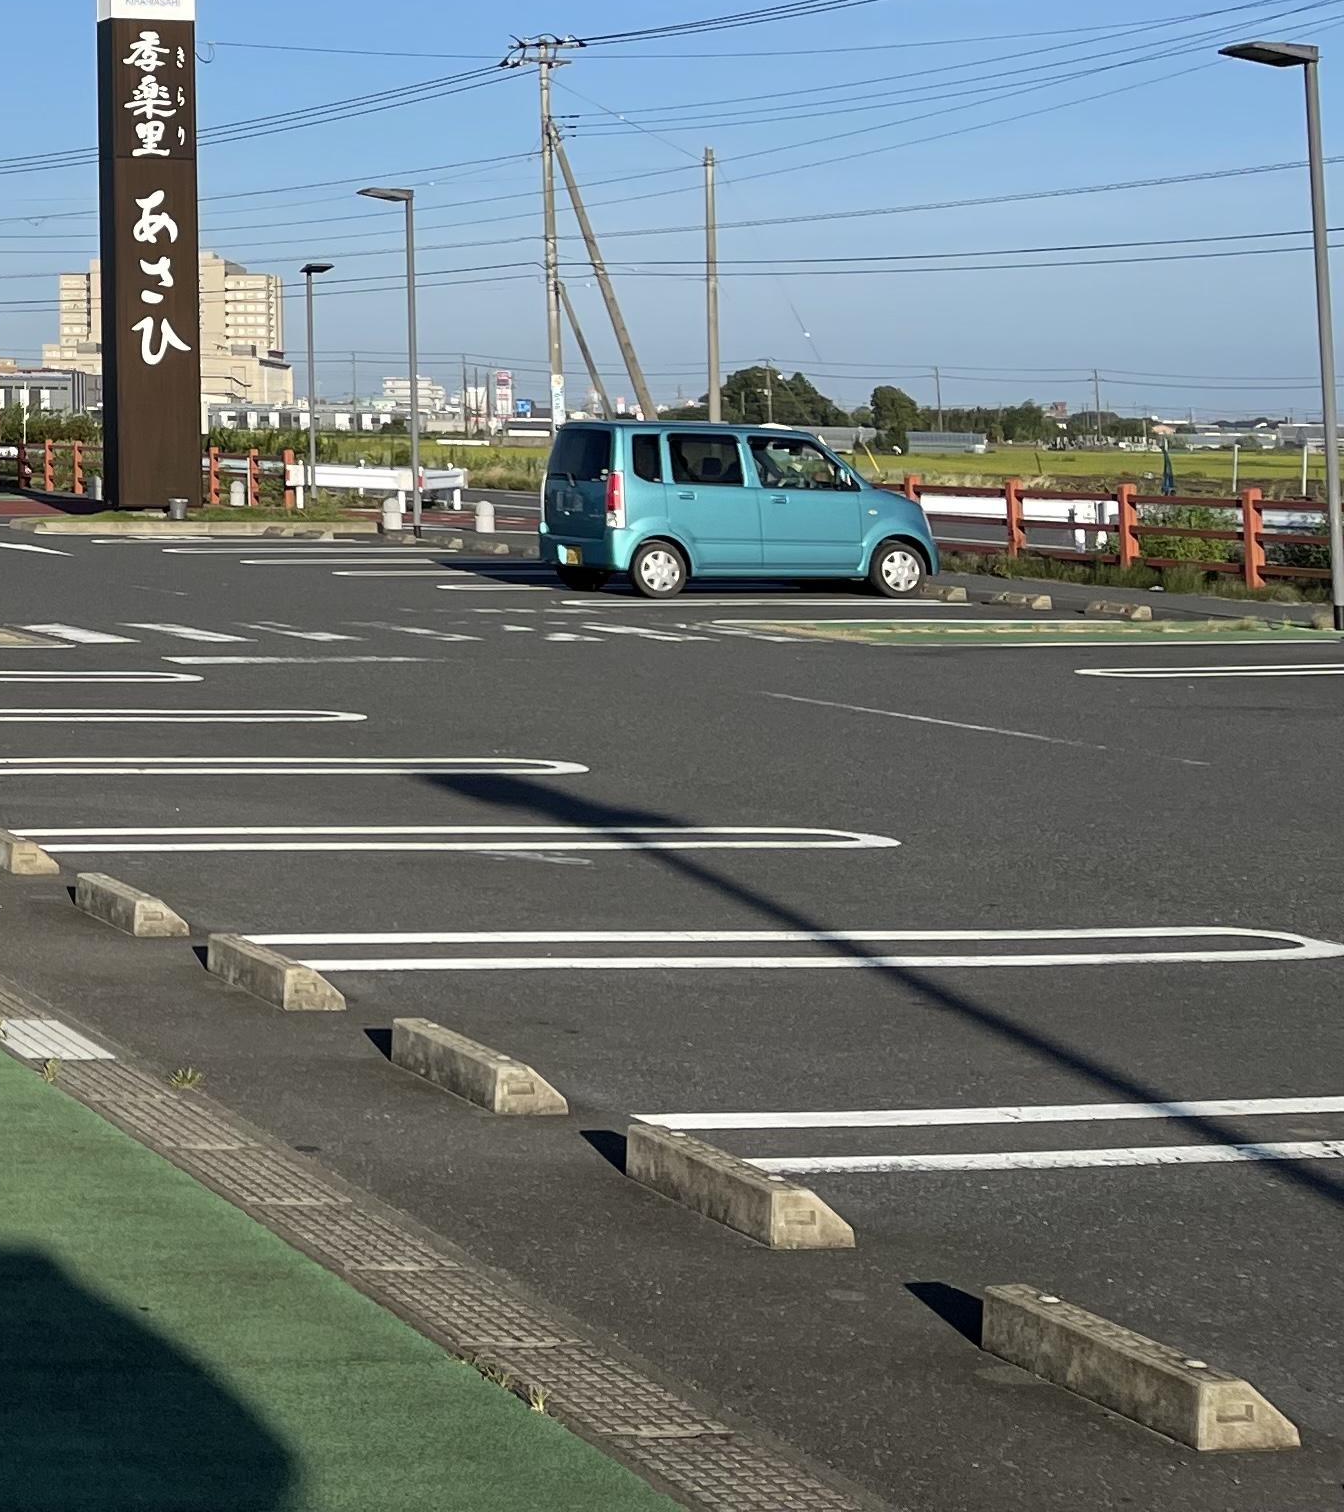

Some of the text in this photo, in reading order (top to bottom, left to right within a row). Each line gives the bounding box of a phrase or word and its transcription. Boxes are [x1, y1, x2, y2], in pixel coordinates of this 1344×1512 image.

[123, 31, 192, 365] 季楽里 あさひ
[176, 46, 186, 146] きらり
